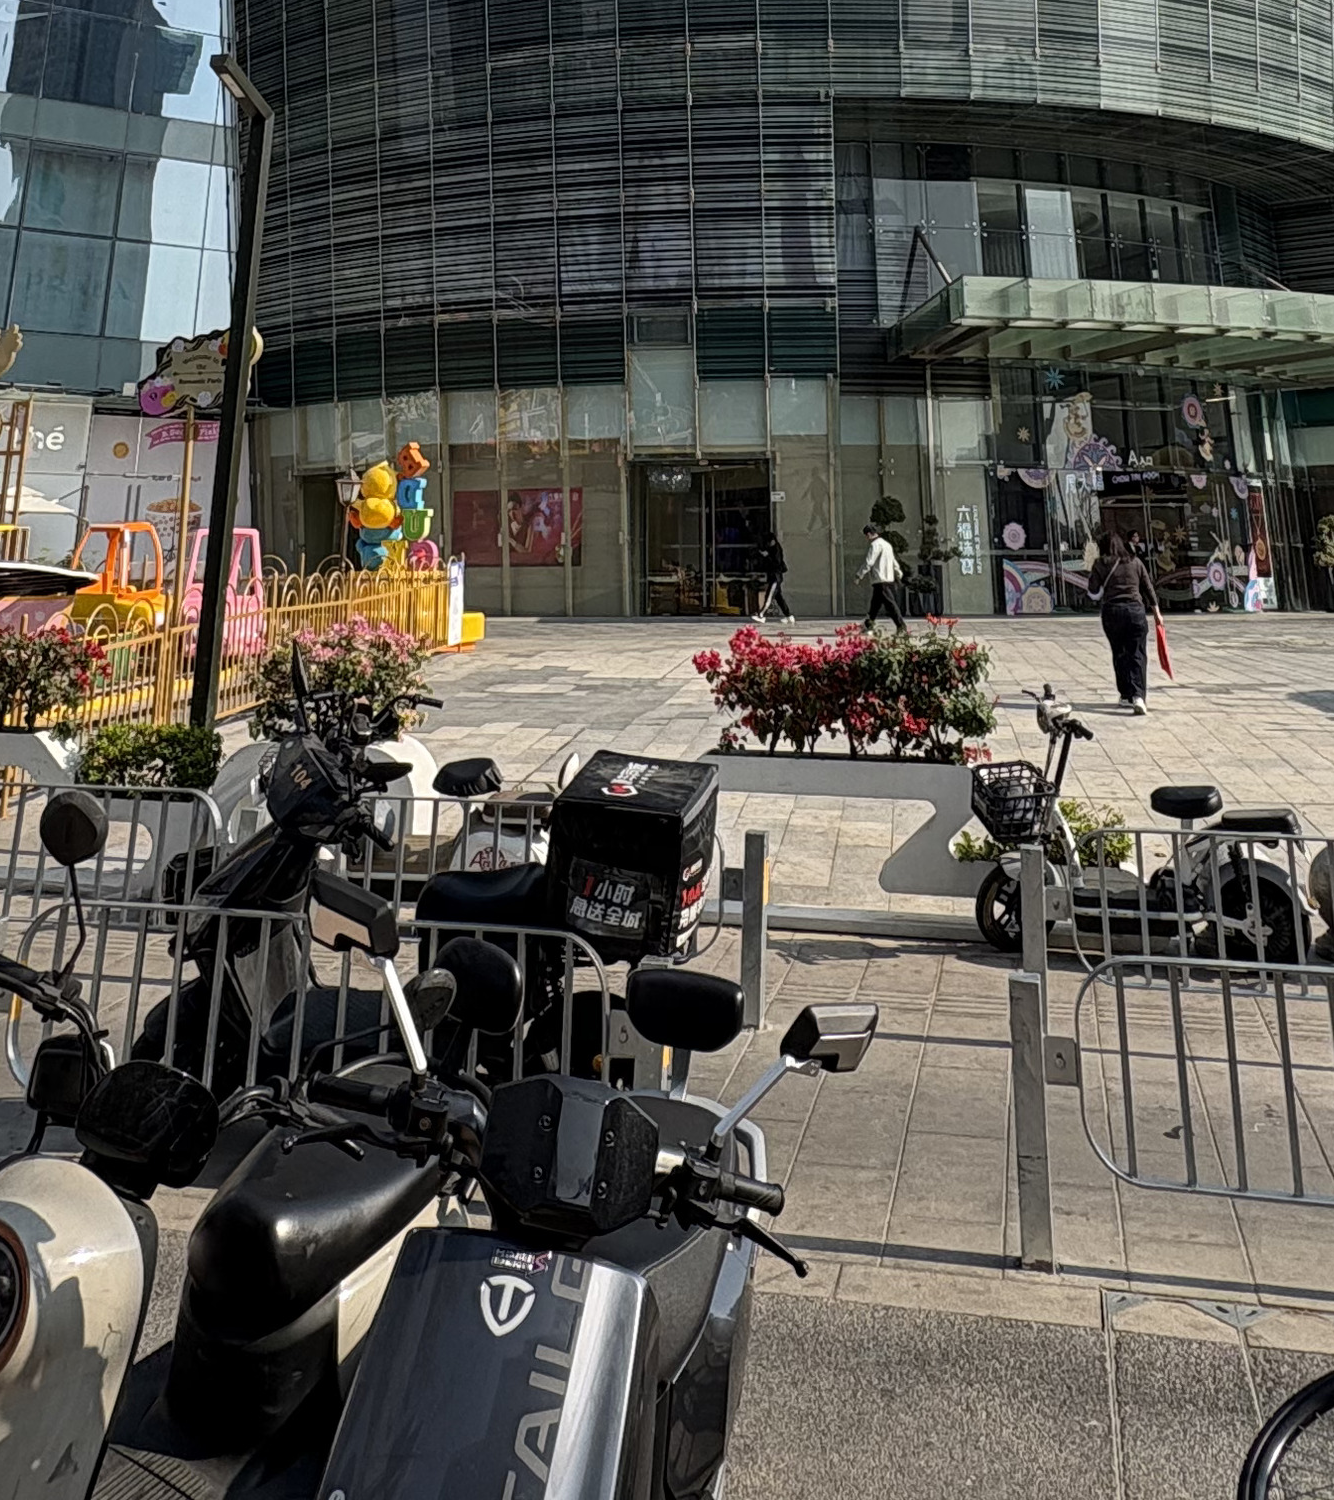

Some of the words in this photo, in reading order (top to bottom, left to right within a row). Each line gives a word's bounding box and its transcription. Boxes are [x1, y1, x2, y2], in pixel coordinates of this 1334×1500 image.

[582, 874, 635, 905] 1小时
[569, 895, 642, 929] 急送全城
[502, 1253, 593, 1500] AILG
